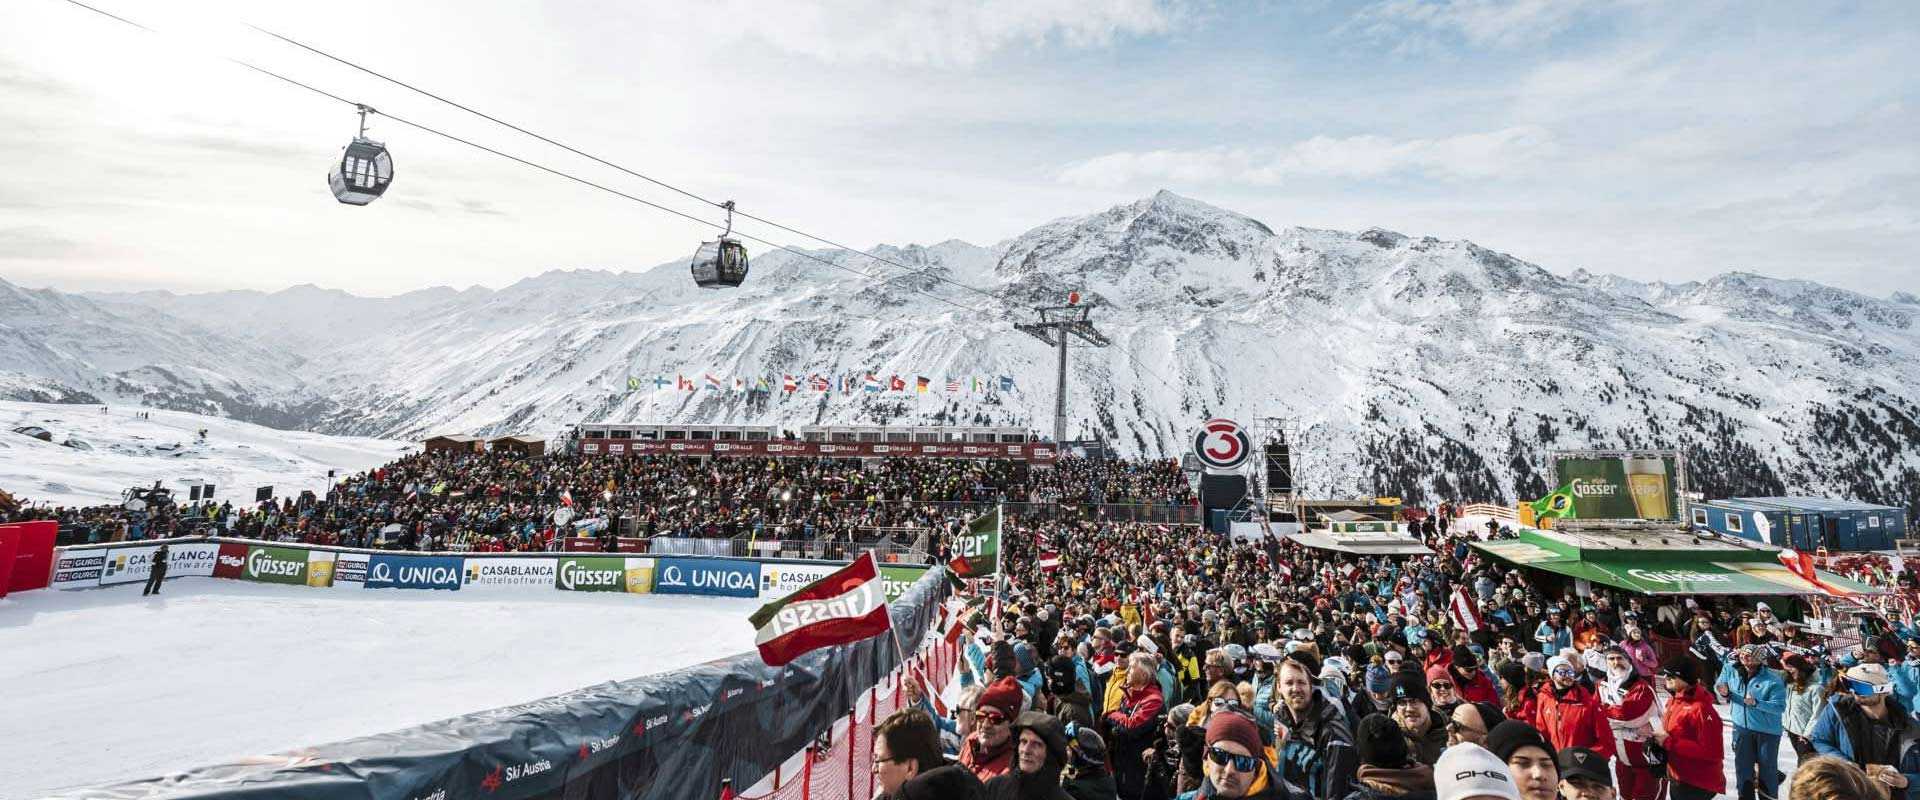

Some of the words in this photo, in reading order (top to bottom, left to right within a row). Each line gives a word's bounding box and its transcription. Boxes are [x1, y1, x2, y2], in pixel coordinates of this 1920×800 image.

[1572, 478, 1617, 498] Gösser
[75, 558, 102, 566] GURGL
[248, 549, 304, 578] Gösser
[482, 566, 554, 576] CASABLANCA
[72, 570, 98, 579] GURGL
[400, 567, 458, 584] UNIQA
[480, 574, 554, 584] hotelsoftware
[560, 560, 622, 590] Gösser
[692, 569, 756, 590] UNIQA
[506, 762, 520, 782] Ski
[522, 758, 551, 777] Austria
